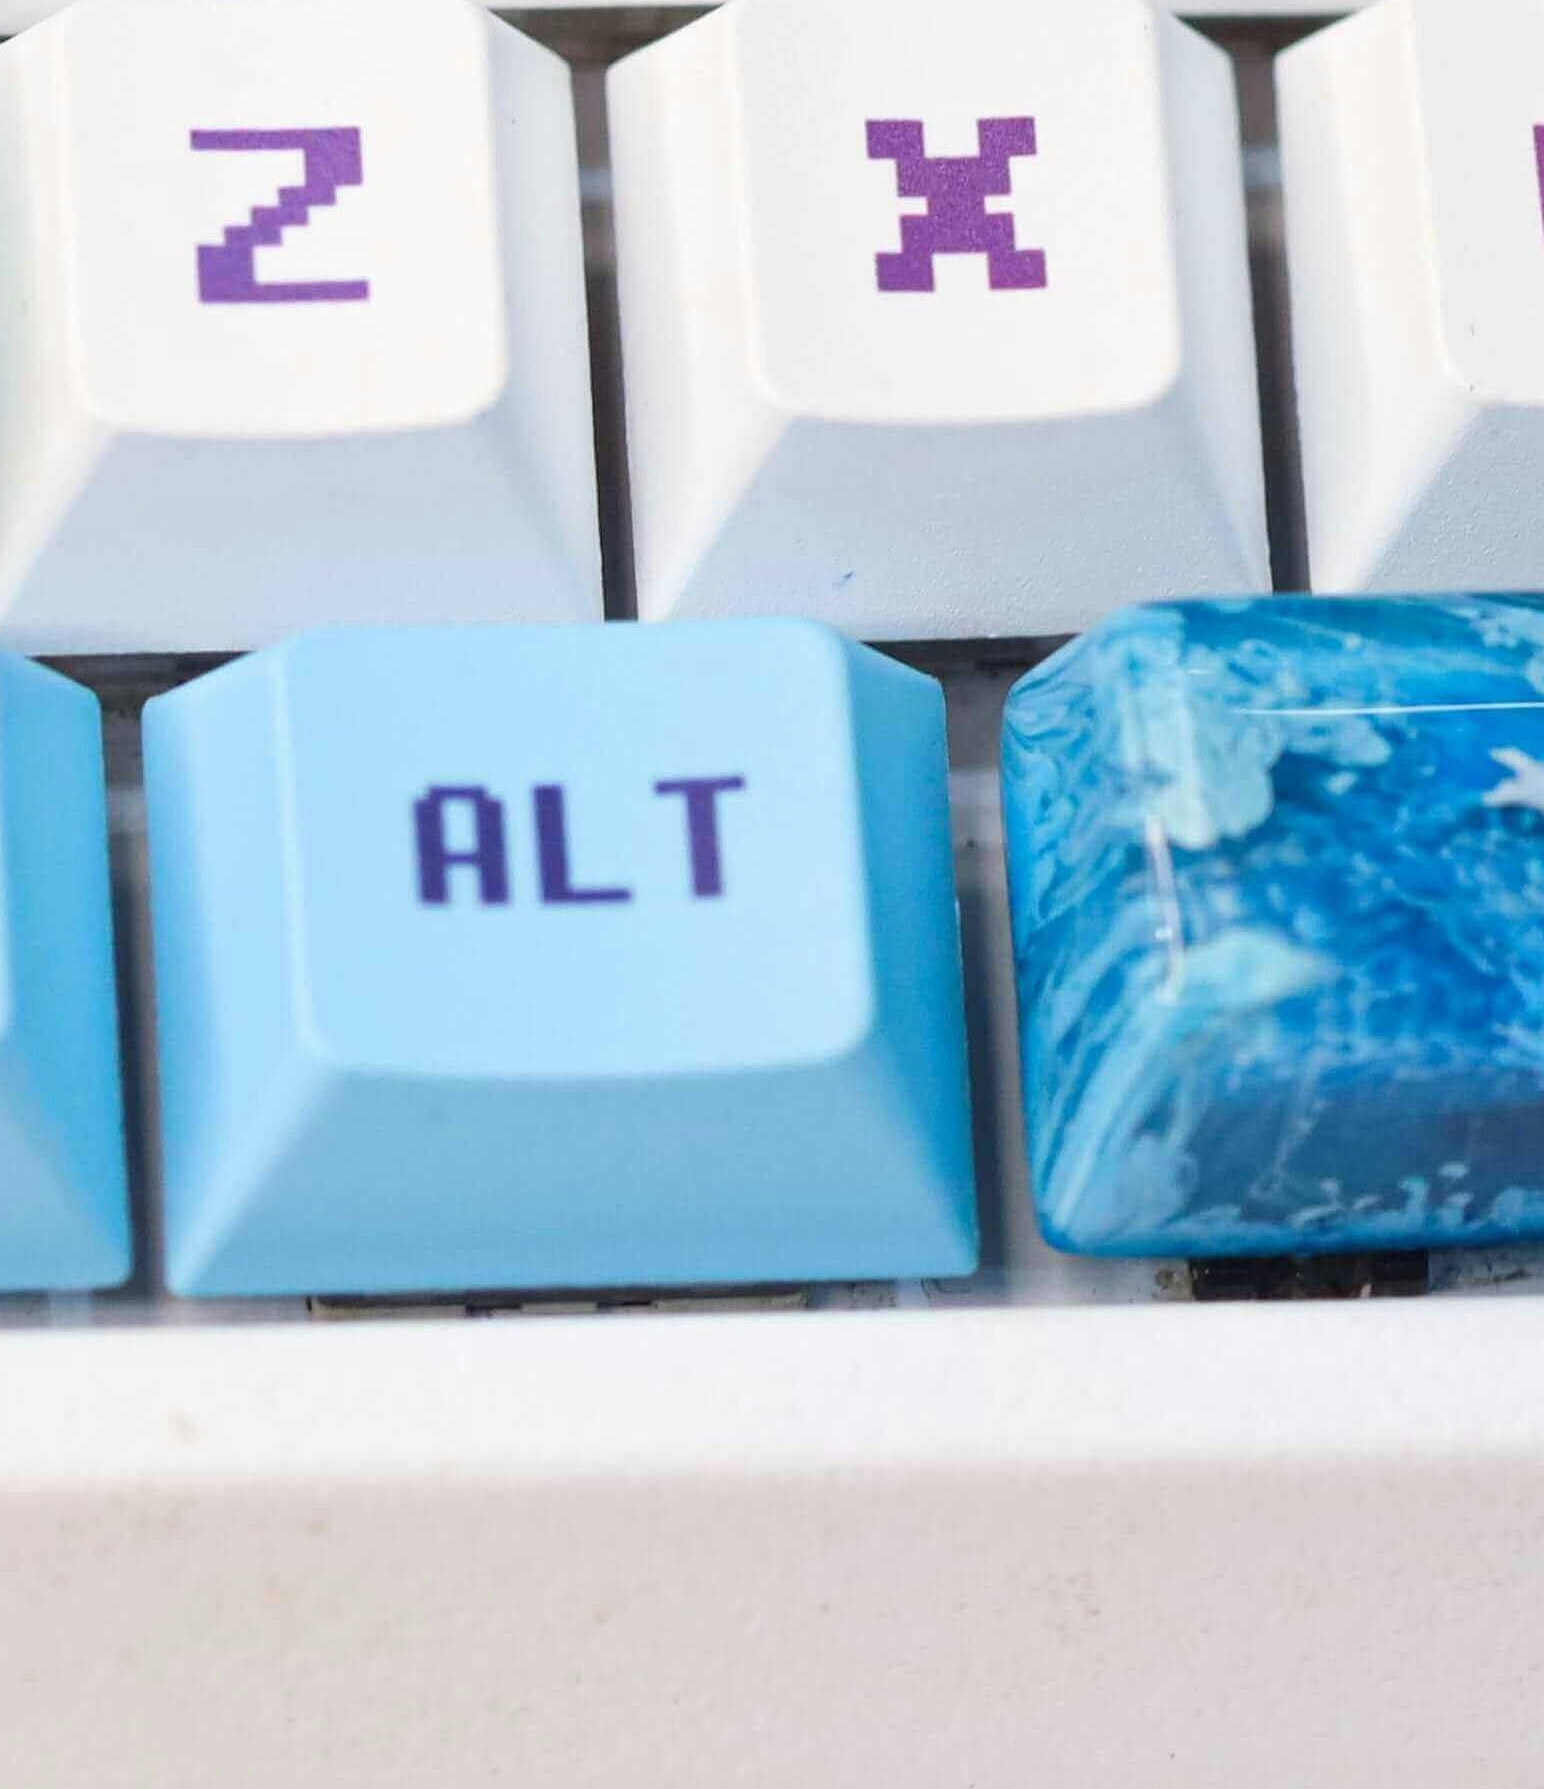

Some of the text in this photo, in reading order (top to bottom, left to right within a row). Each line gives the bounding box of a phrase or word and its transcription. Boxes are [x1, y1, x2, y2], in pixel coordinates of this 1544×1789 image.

[191, 125, 369, 304] Z
[866, 116, 1045, 291] X
[412, 775, 745, 906] ALT
